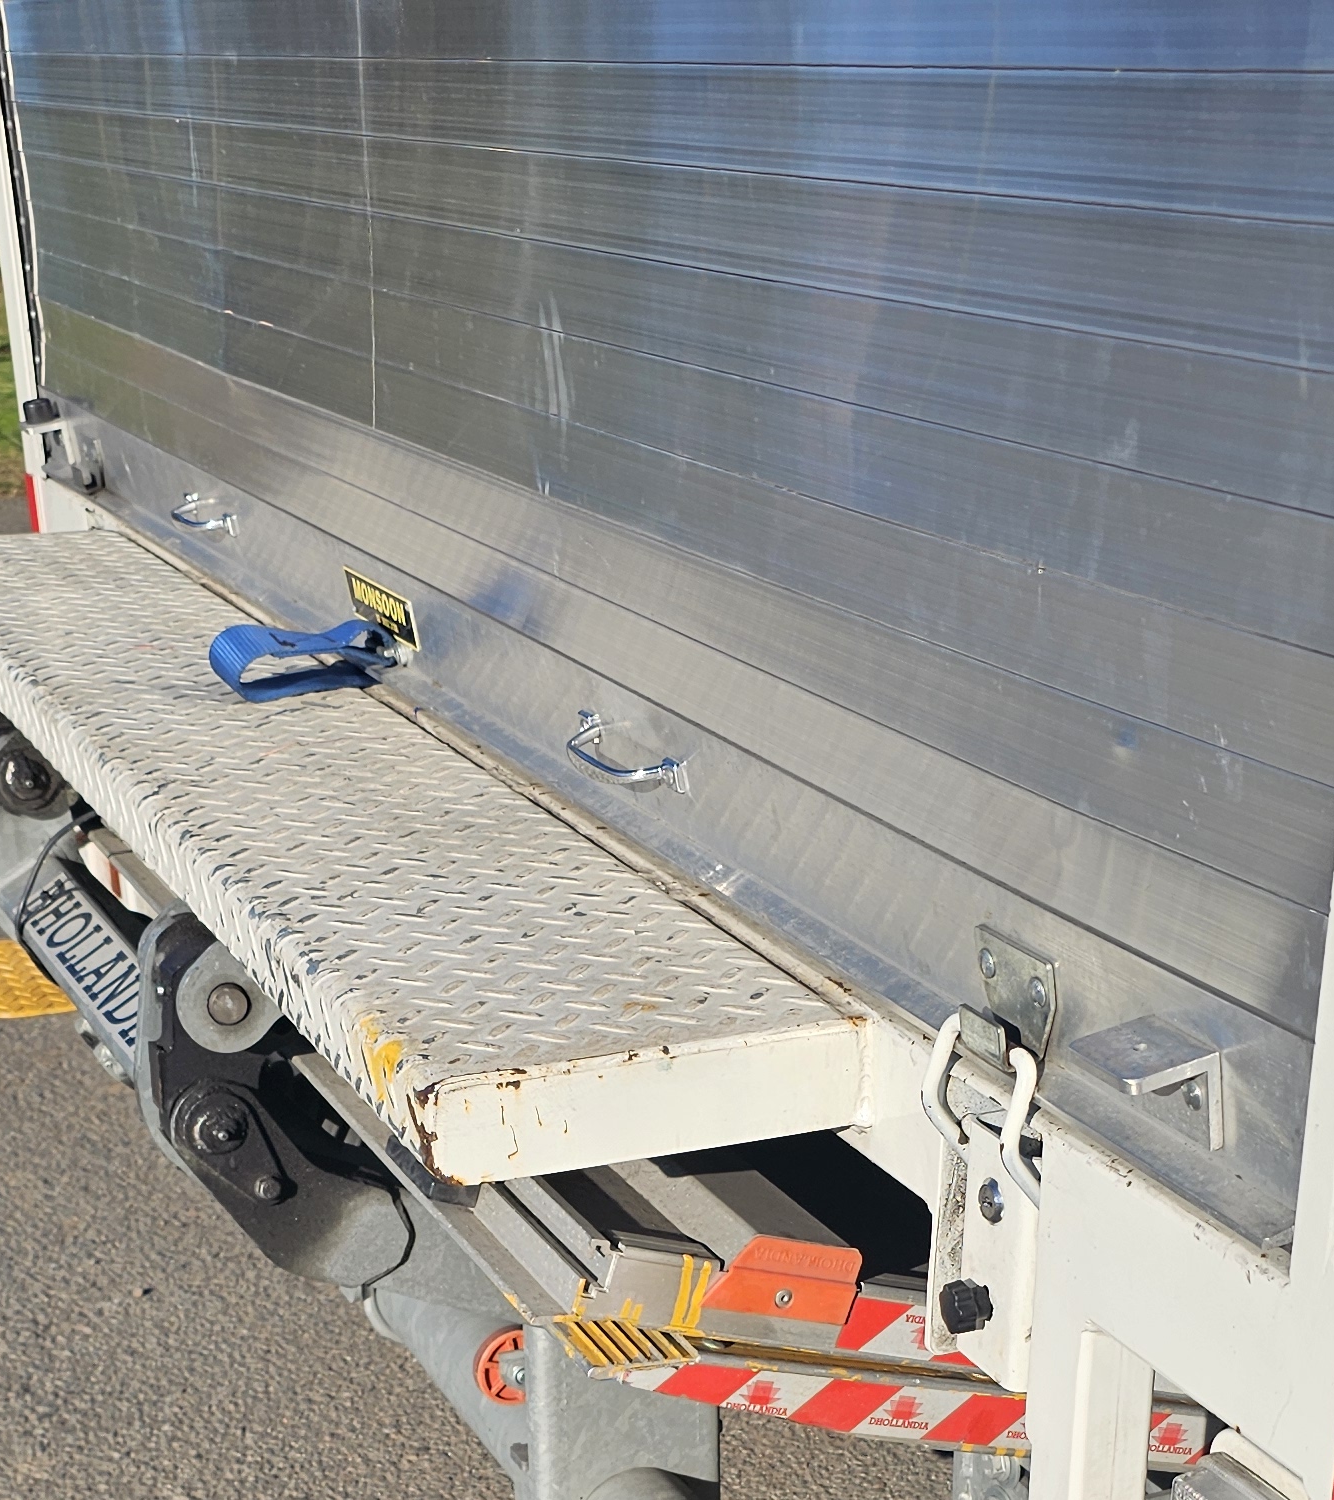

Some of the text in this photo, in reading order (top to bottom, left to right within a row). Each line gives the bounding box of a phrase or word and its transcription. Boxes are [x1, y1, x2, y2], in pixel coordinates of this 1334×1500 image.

[351, 577, 406, 627] MONSOON
[726, 1402, 787, 1416] DHOLLANDIA
[868, 1417, 929, 1430] DHOLLANDIA
[1148, 1444, 1192, 1455] OLLANDIA
